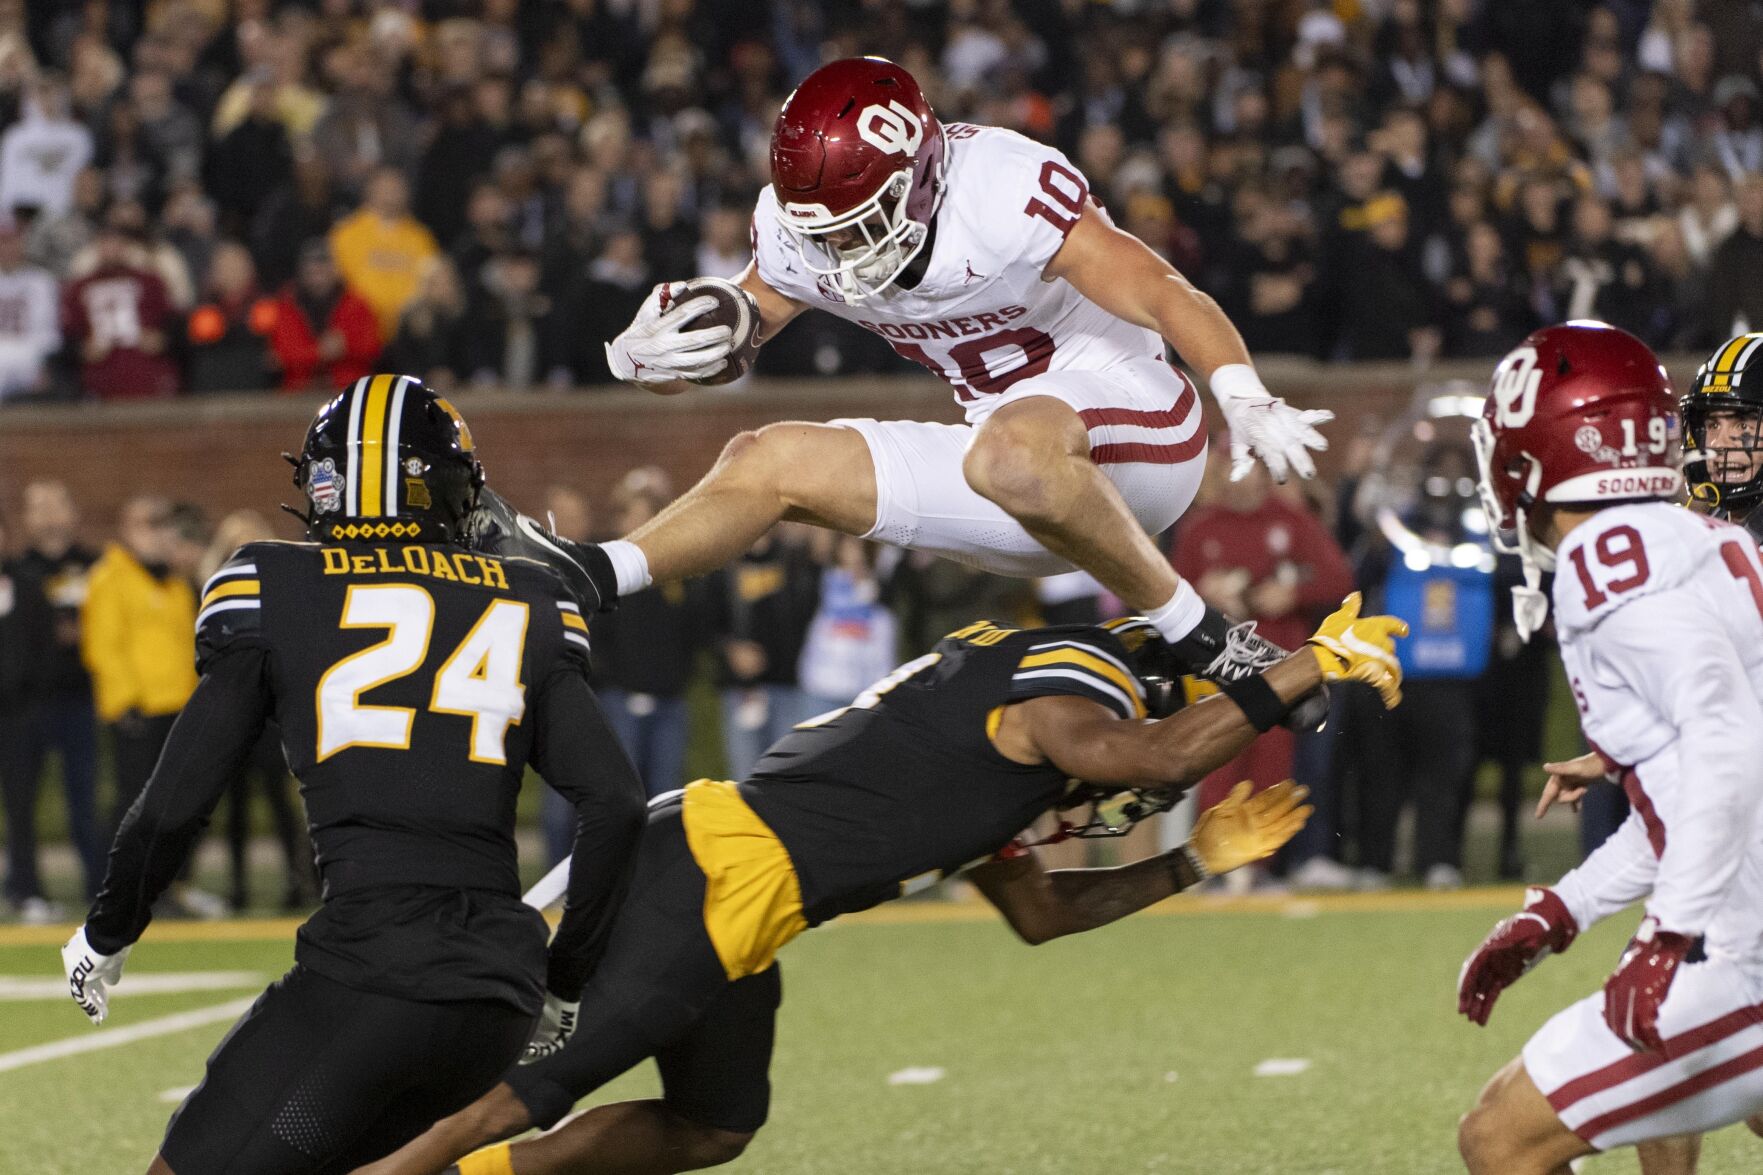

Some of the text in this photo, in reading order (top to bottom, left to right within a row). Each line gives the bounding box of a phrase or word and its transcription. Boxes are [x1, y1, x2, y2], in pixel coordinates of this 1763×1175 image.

[1024, 160, 1087, 239] 10
[858, 304, 1028, 340] SOONERS
[1621, 418, 1666, 456] 19
[1569, 524, 1650, 612] 19
[316, 583, 529, 765] 24
